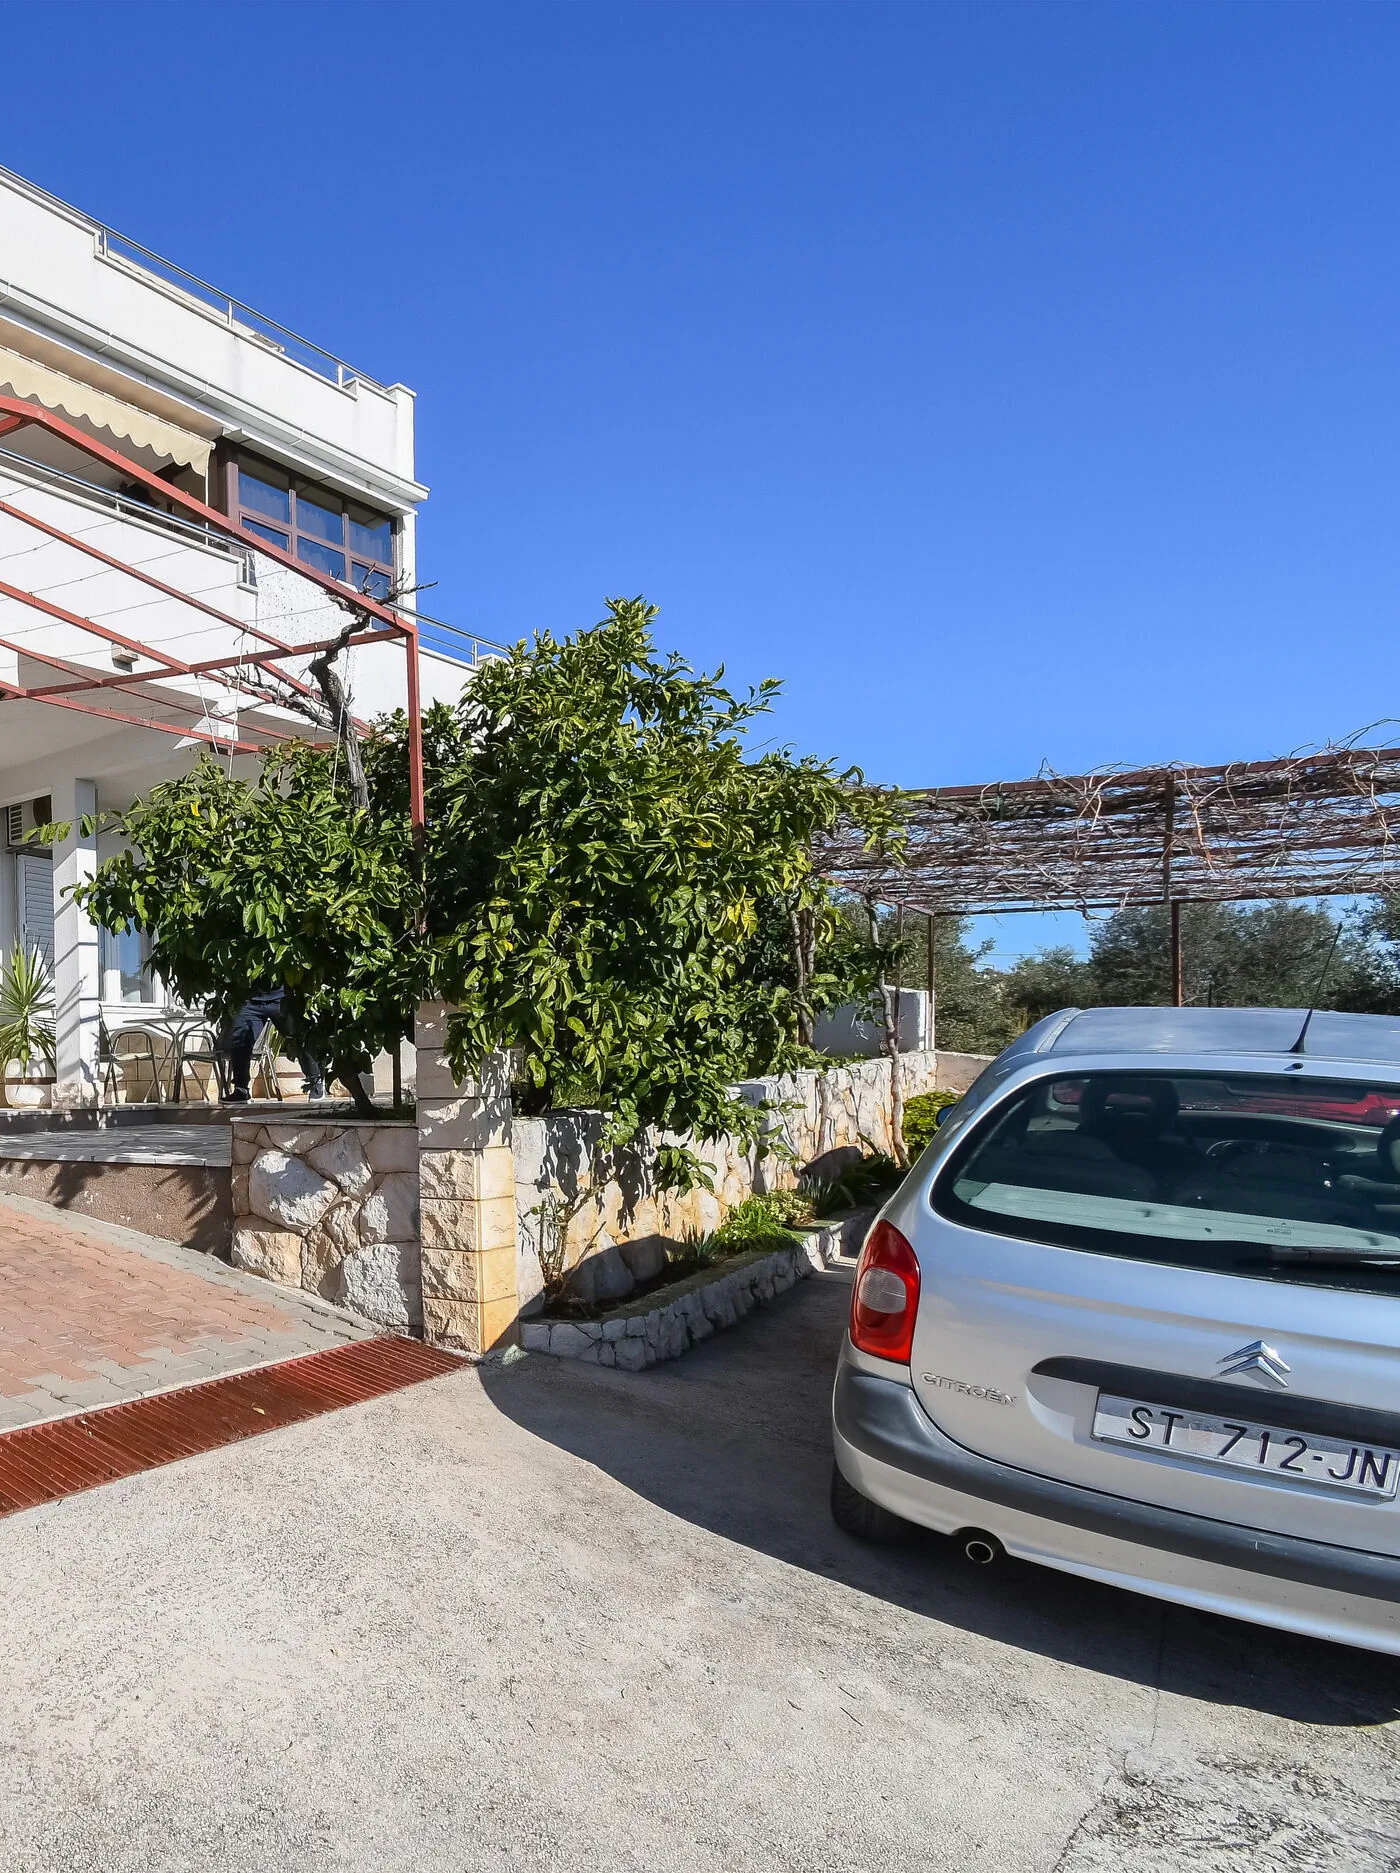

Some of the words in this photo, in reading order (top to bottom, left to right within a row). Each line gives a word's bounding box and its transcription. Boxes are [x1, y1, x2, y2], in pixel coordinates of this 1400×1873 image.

[920, 1371, 1018, 1407] CITROËN
[1127, 1406, 1184, 1445] ST
[1217, 1423, 1392, 1488] 712-JN
